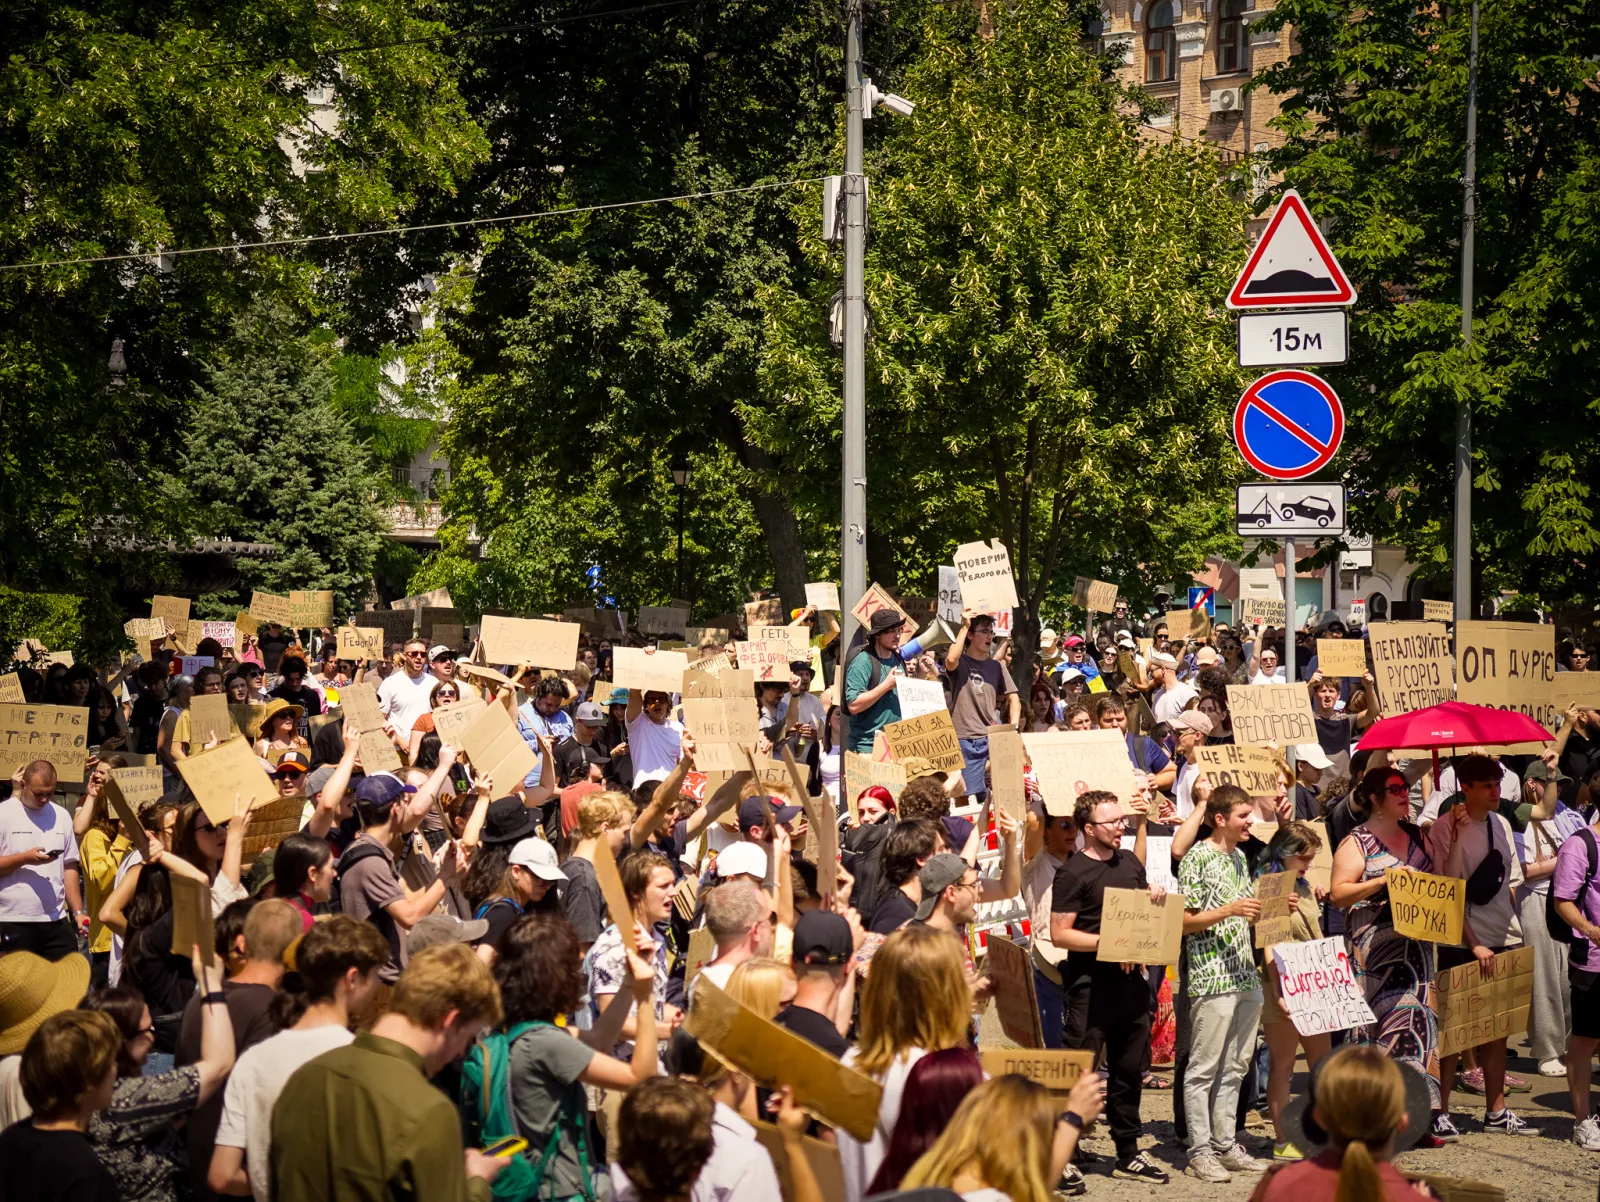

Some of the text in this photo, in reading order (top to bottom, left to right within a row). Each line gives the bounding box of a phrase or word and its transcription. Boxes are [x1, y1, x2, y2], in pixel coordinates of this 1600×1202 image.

[761, 629, 790, 639] ГЕТЬ
[740, 653, 789, 664] ФЕДОРОВА
[1375, 632, 1449, 661] ЛЕГАЛІЗУЙТЕ
[1387, 662, 1440, 688] РУСОРІЗ
[1462, 646, 1554, 683] ОП ДУРІЄ
[1231, 688, 1307, 711] РУКИ ГЕТЬ
[1393, 691, 1408, 712] НЕ
[11, 709, 88, 726] НЕ ТРЕБА
[931, 716, 945, 730] ЗА
[1233, 713, 1313, 742] ФЕДОРОВА
[1226, 746, 1245, 764] НЕ
[1390, 872, 1456, 900] КРУГОВА
[1395, 902, 1448, 935] ПОРУКА
[1438, 955, 1523, 992] СИРИК
